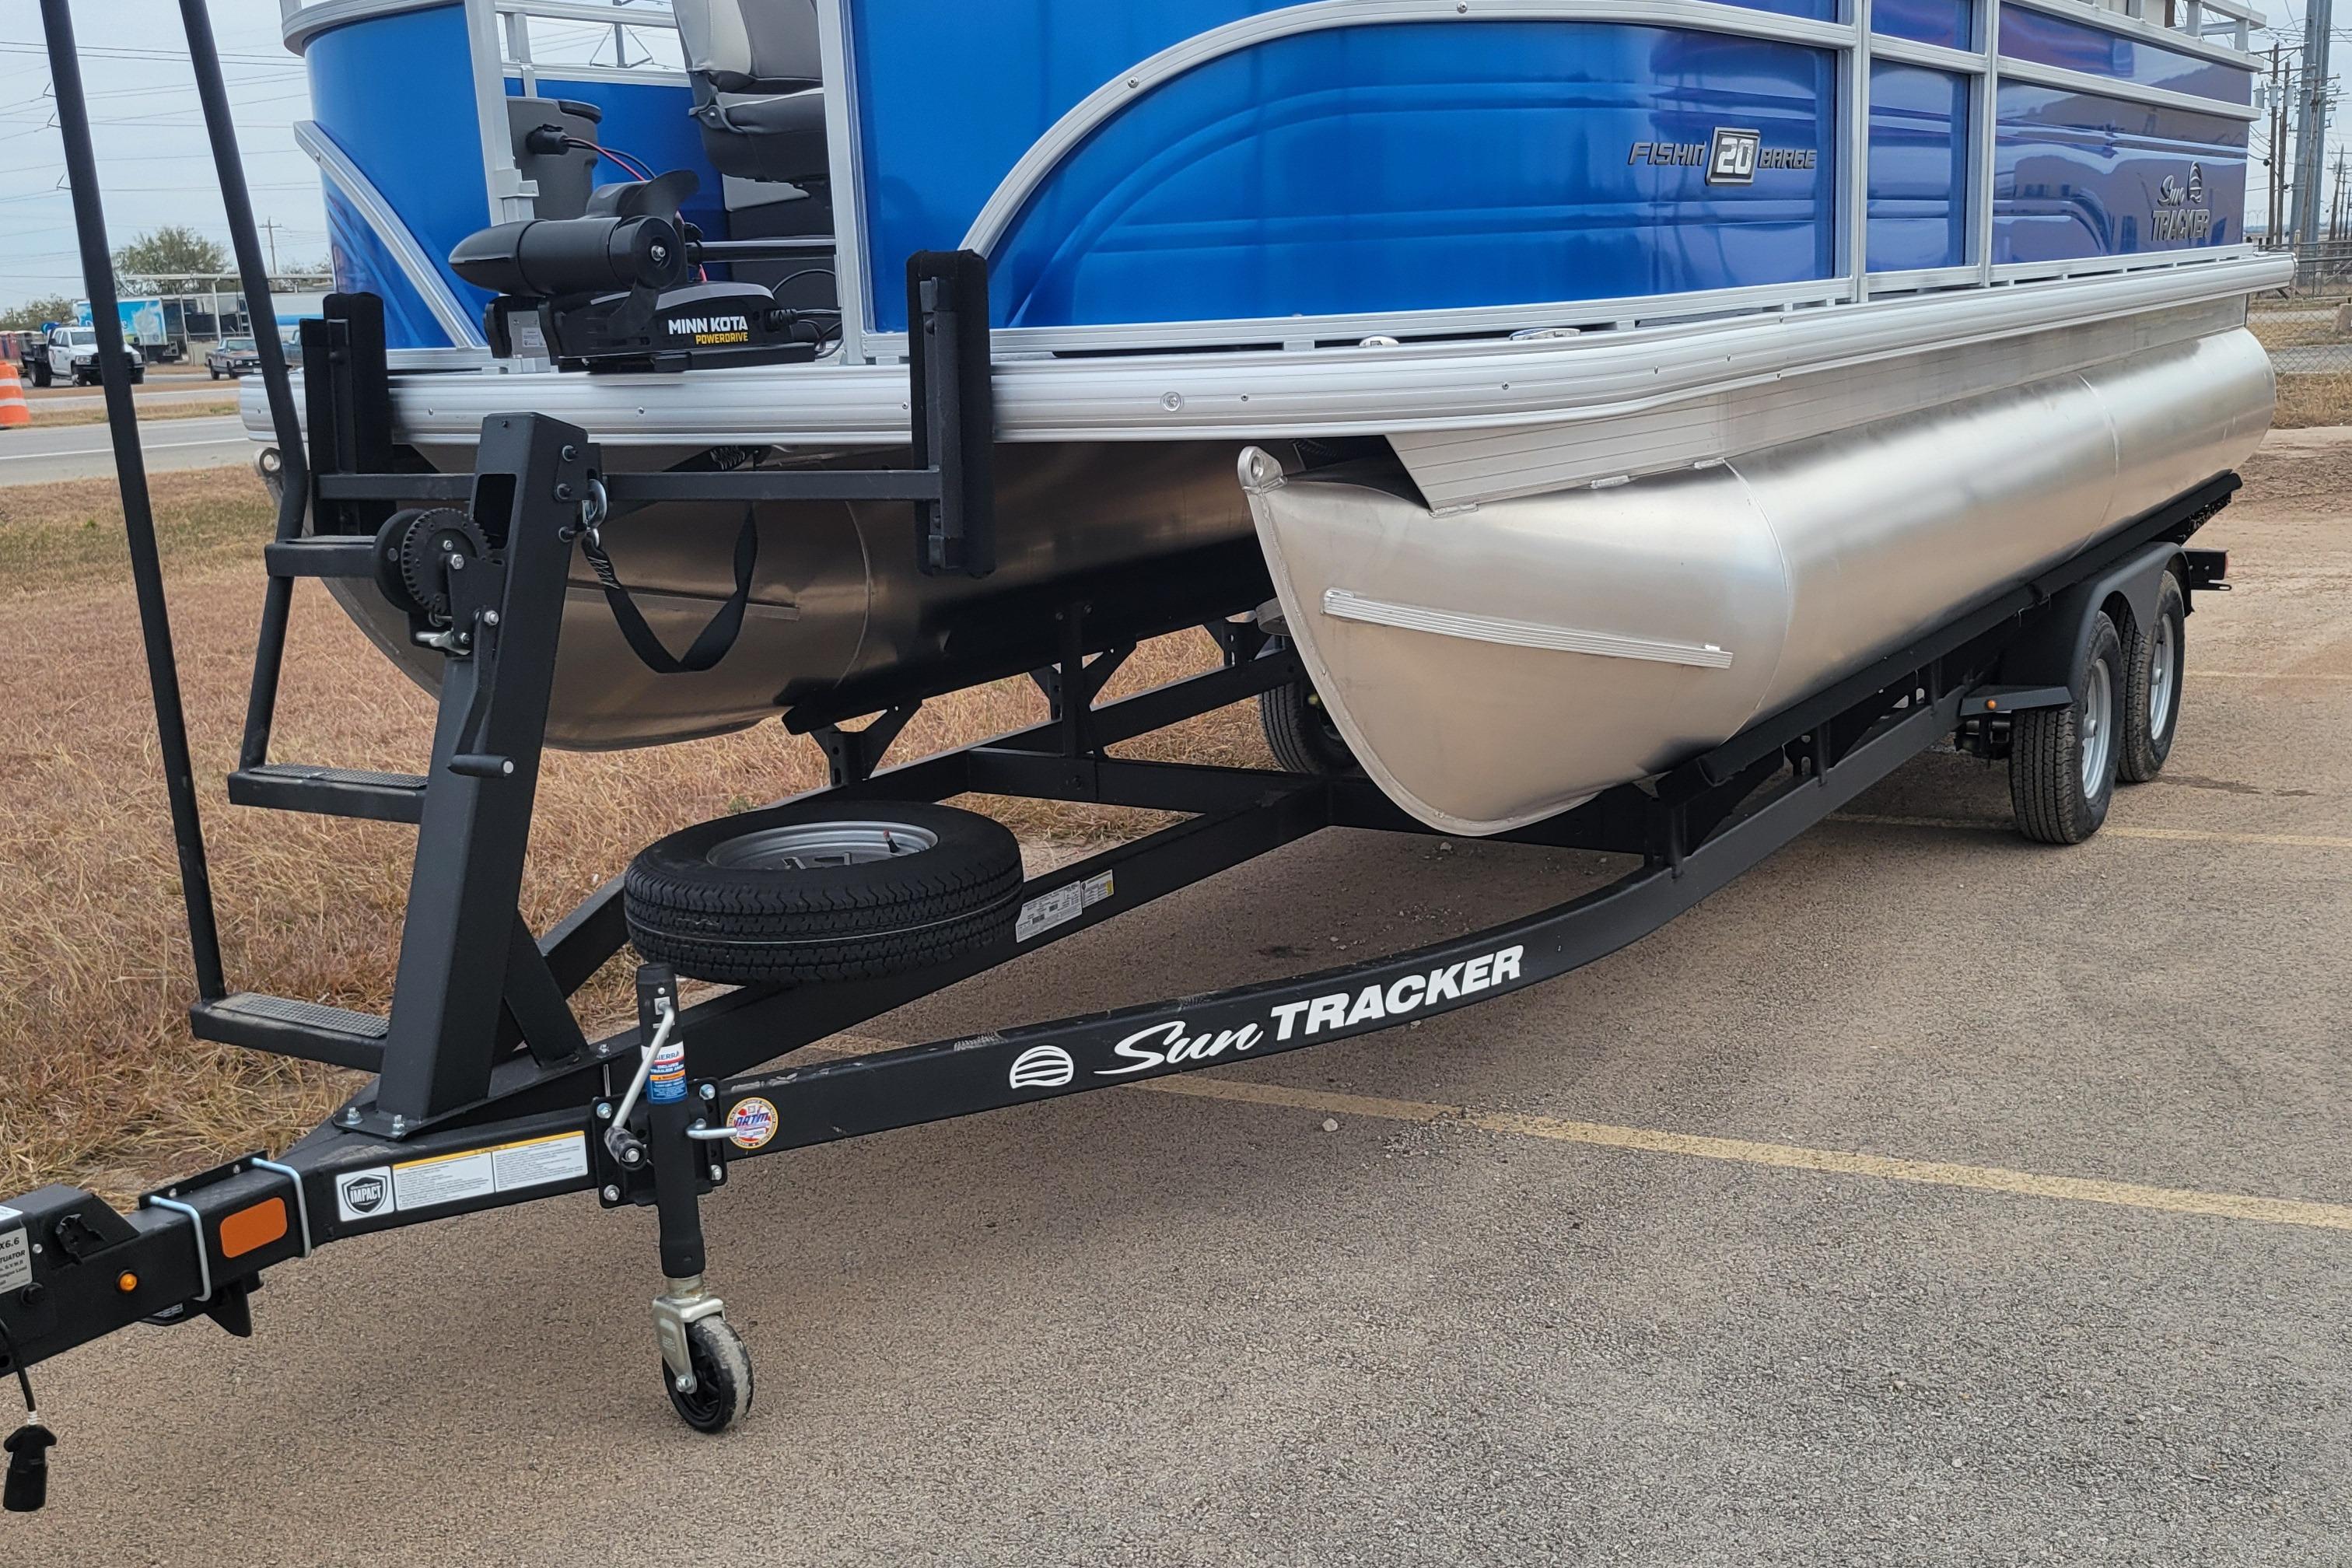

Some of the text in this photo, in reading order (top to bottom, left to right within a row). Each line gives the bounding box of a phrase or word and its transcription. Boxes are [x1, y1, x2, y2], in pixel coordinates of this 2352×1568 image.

[1717, 137, 1755, 175] 20
[1759, 149, 1818, 170] BARGE
[2158, 175, 2185, 206] Sun
[2151, 209, 2210, 241] TRACKER
[668, 315, 749, 335] MINN KOTA
[695, 331, 749, 345] POWERDRIVE
[1094, 944, 1524, 1075] Sun TRACKER
[655, 1051, 680, 1061] IERRA
[350, 1185, 382, 1204] IMPACT
